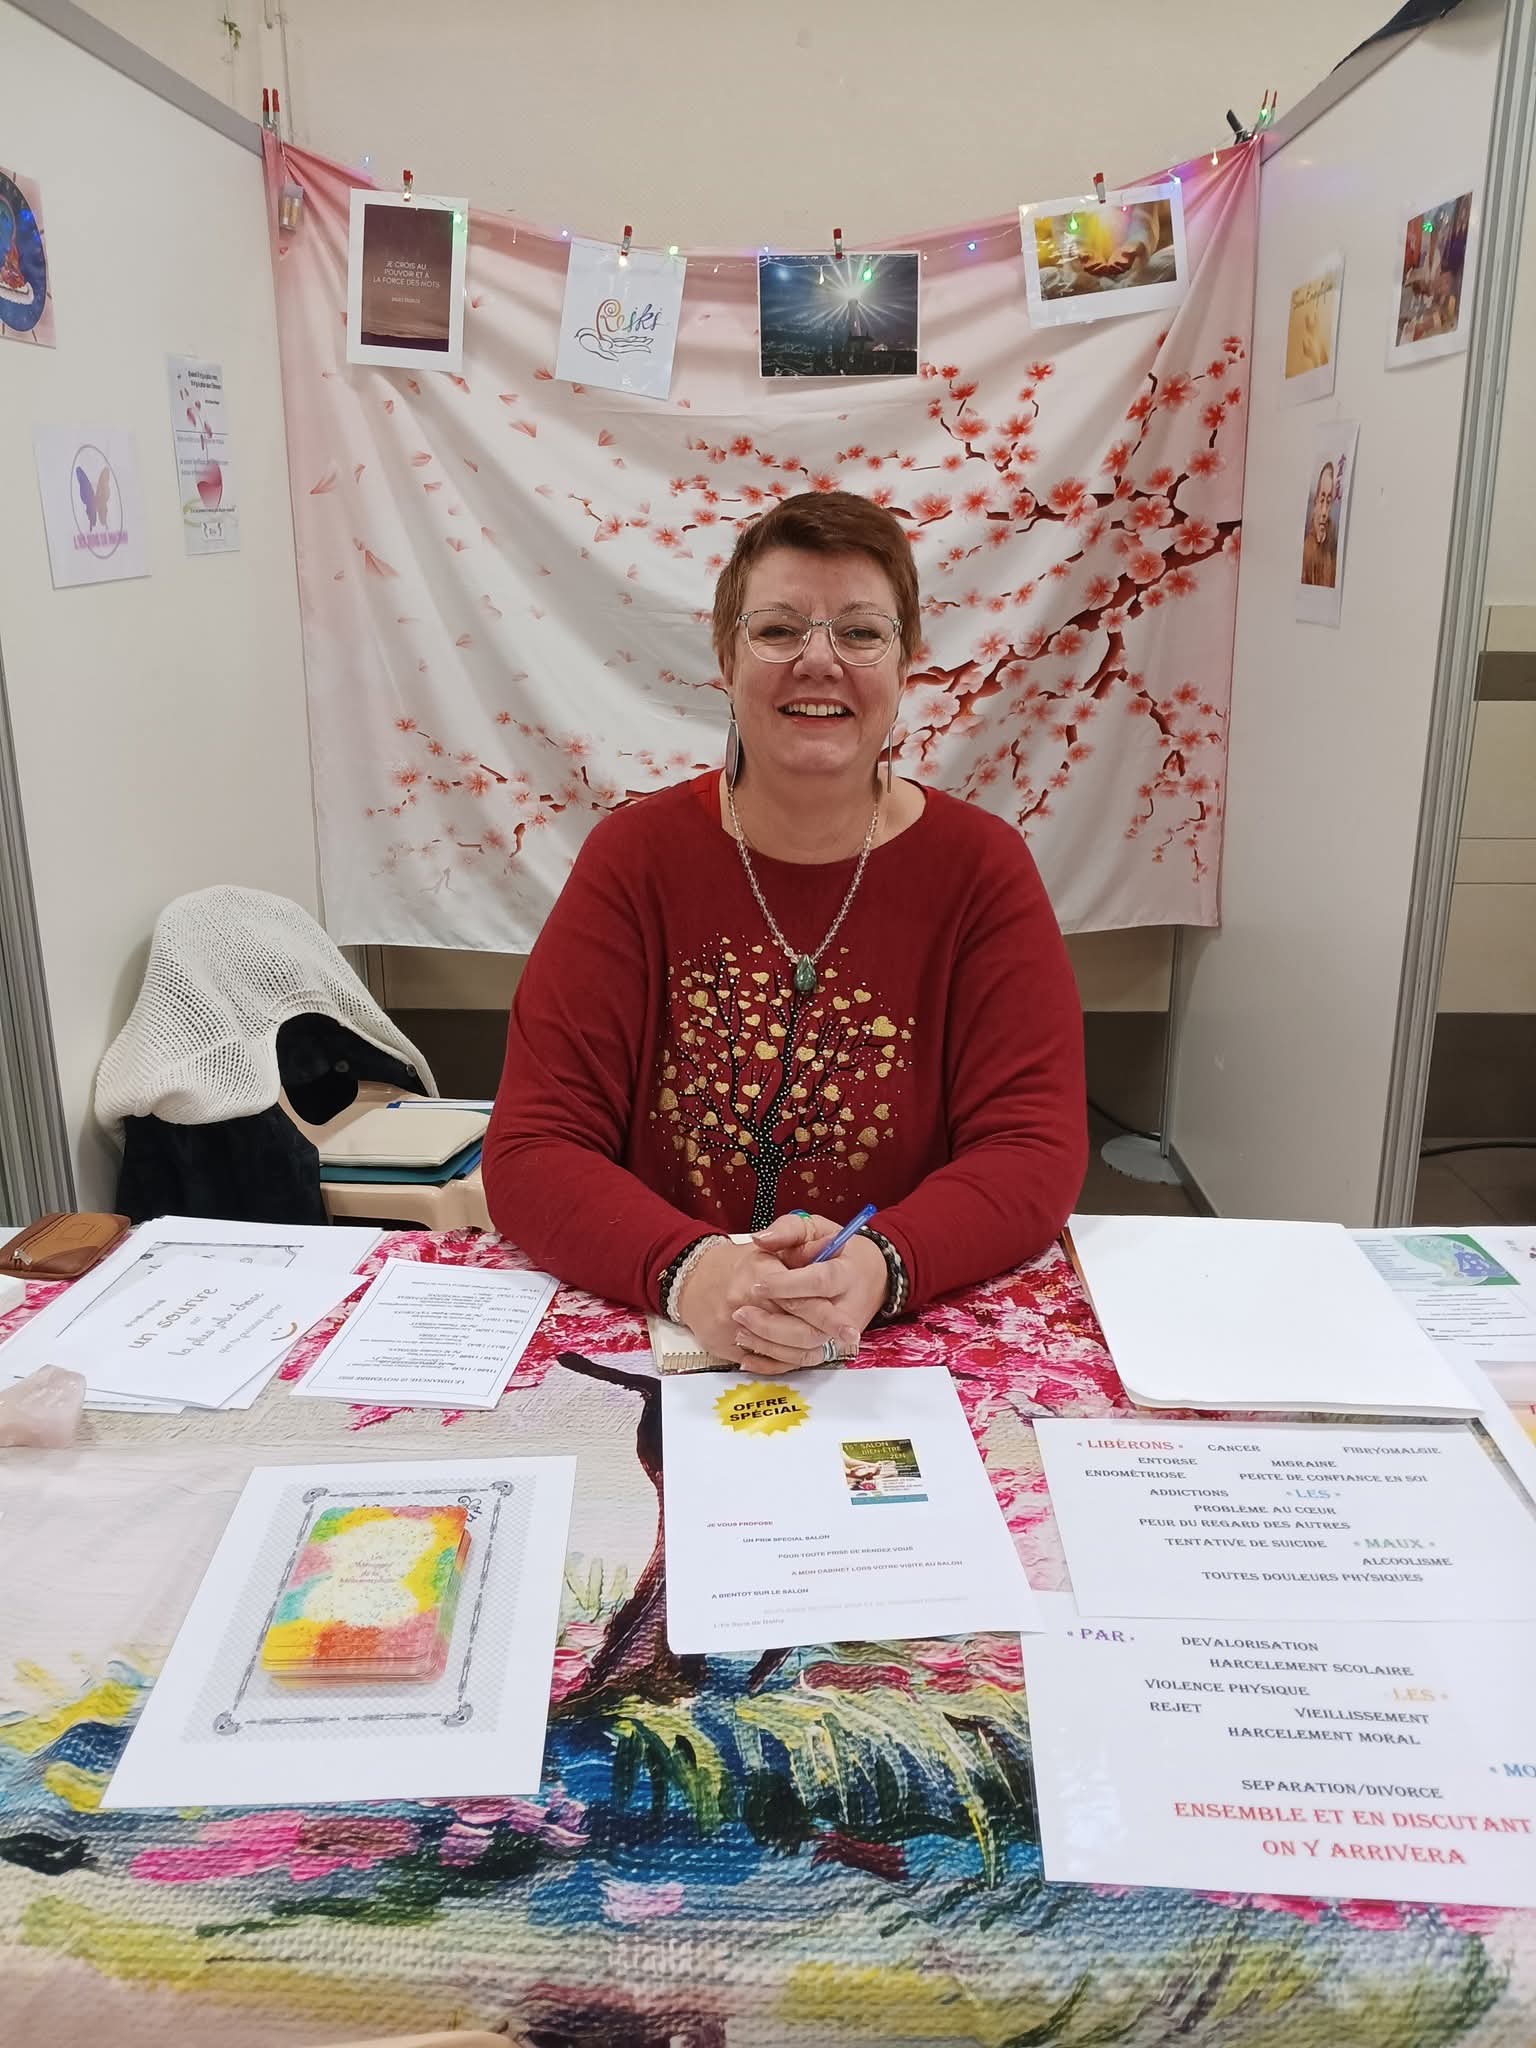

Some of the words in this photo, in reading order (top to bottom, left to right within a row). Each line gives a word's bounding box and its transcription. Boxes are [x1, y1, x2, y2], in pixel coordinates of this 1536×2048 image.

[394, 261, 416, 269] CROIS
[384, 268, 415, 278] POUVOIR
[382, 277, 406, 286] FORCE
[407, 279, 420, 287] DES
[128, 1333, 158, 1349] un
[157, 1287, 219, 1329] sourire
[733, 1396, 788, 1411] OFFRE
[729, 1404, 802, 1422] SPÉCIAL
[1207, 1443, 1261, 1452] CANCER
[1138, 1457, 1198, 1465] ENTORSE
[1271, 1459, 1337, 1468] MIGRAINE
[1085, 1469, 1187, 1479] ENDOMÉTRIOSE
[1239, 1472, 1284, 1480] PERTE
[1306, 1474, 1382, 1482] CONFIANCE
[1149, 1488, 1229, 1497] ADDICTIONS
[1295, 1489, 1331, 1499] LES
[1294, 1506, 1337, 1514] CŒUR
[1138, 1518, 1176, 1527] PEUR
[1179, 1519, 1197, 1527] DU
[1201, 1519, 1260, 1528] REGARD
[1263, 1520, 1291, 1528] DES
[1295, 1521, 1351, 1529] AUTRES
[1164, 1537, 1246, 1547] TENTATIVE
[1249, 1539, 1269, 1547] DE
[1271, 1540, 1327, 1548] SUICIDE
[1364, 1538, 1424, 1549] MAUX
[801, 1550, 826, 1558] TOUTE
[861, 1546, 891, 1554] RENDEZ
[1362, 1557, 1453, 1566] ALCOOLISME
[817, 1566, 850, 1574] CABINET
[1201, 1571, 1260, 1581] TOUTES
[1262, 1572, 1338, 1582] DOULEURS
[1341, 1573, 1424, 1582] PHYSIQUES
[718, 1591, 752, 1599] BIENTOT
[782, 1587, 809, 1595] SALON
[1080, 1628, 1126, 1643] PAR
[1181, 1636, 1319, 1651] DEVALORISATION
[1209, 1658, 1328, 1672] HARCELEMENT
[1332, 1663, 1414, 1676] SCOLAIRE
[1144, 1679, 1224, 1693] VIOLENCE
[1228, 1683, 1310, 1696] PHYSIQUE
[1392, 1687, 1436, 1701] LES
[1149, 1701, 1202, 1713] REJET
[1294, 1707, 1429, 1724] VIEILLISSEMENT
[1227, 1726, 1353, 1742] HARCELEMENT
[1358, 1732, 1421, 1745] MORAL
[1241, 1779, 1443, 1799] SEPARATION/DIVORCE
[1174, 1802, 1308, 1823] ENSEMBLE
[1313, 1808, 1344, 1825] ET
[1352, 1810, 1386, 1826] EN
[1392, 1812, 1532, 1833] DISCUTANT
[1262, 1839, 1297, 1857] ON
[1303, 1838, 1320, 1857] Y
[1330, 1843, 1467, 1865] ARRIVERA
